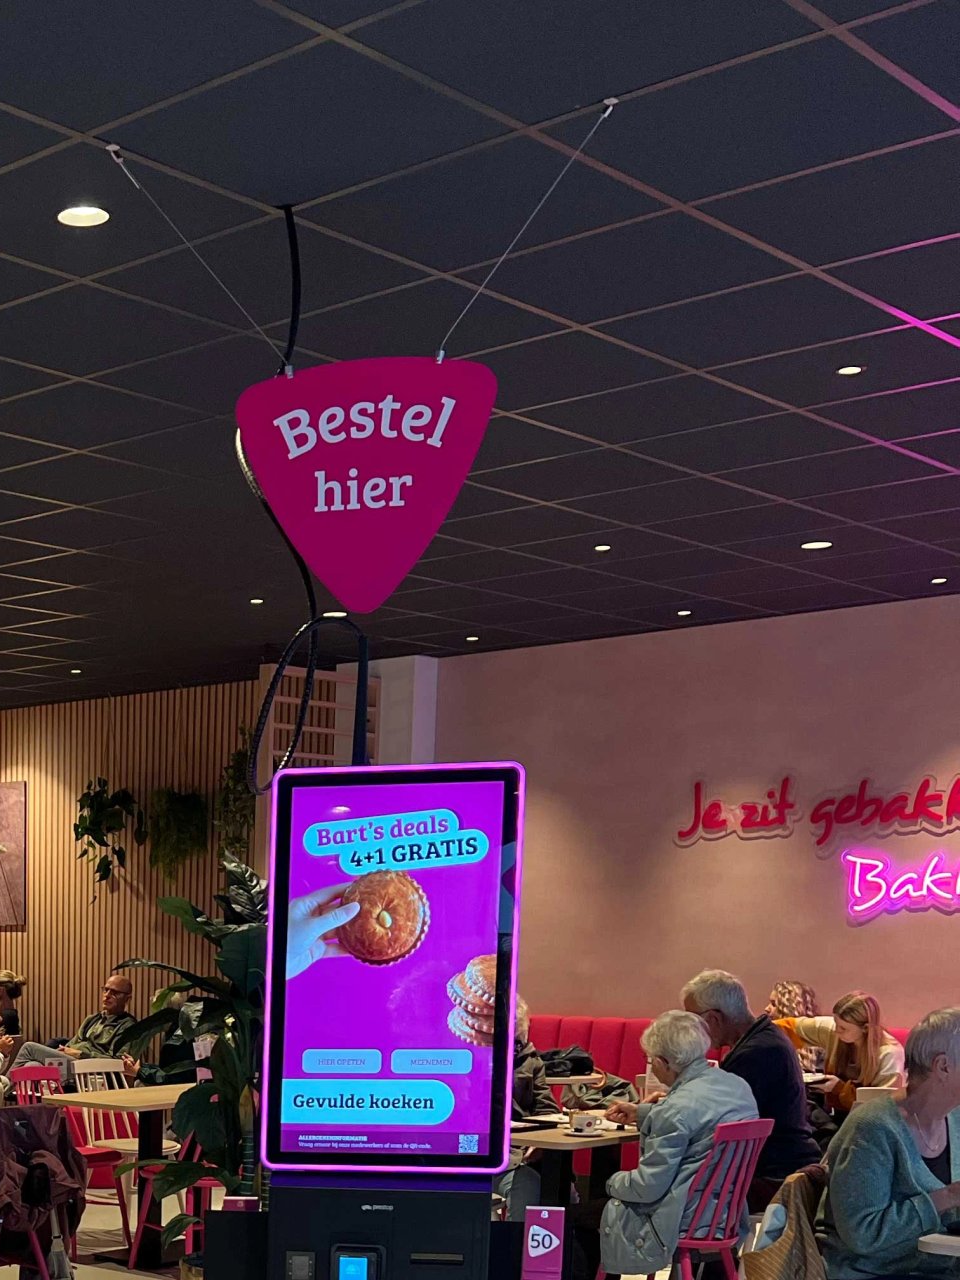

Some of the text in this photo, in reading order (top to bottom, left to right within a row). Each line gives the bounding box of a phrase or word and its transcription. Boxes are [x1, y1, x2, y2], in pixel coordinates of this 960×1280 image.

[272, 393, 457, 460] Bestel
[314, 468, 413, 513] hier
[677, 780, 728, 840] Je
[740, 776, 796, 829] zit
[316, 815, 449, 846] Bart's deals
[351, 837, 477, 867] 4+1 GRATIS
[845, 854, 960, 913] Bak
[293, 1093, 435, 1110] Gevulde koeken
[530, 1233, 553, 1249] 50
